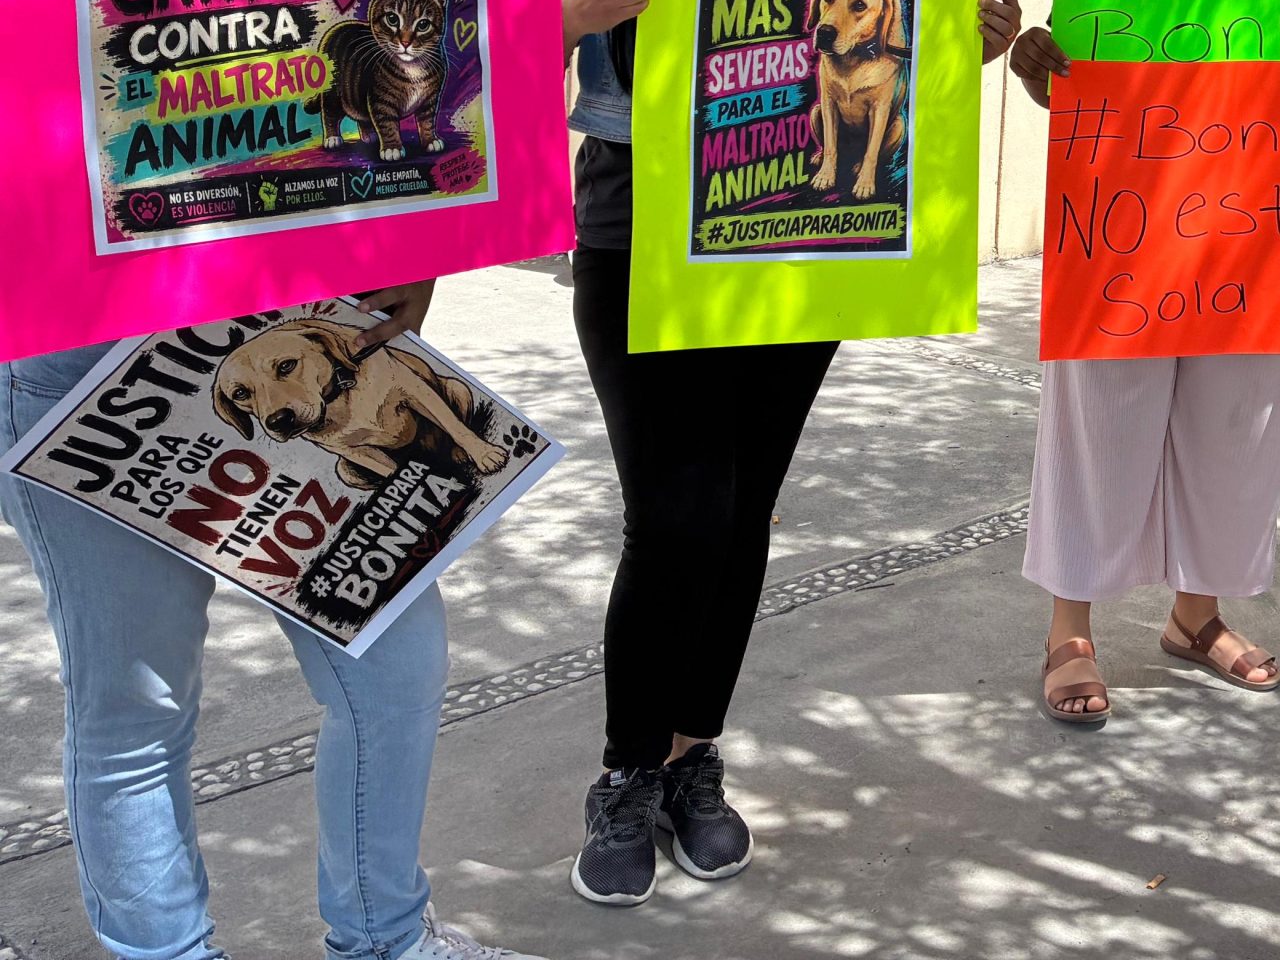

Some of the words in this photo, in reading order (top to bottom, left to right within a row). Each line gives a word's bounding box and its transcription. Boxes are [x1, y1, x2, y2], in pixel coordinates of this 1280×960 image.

[129, 7, 301, 65] CONTRA
[126, 80, 152, 101] EL
[158, 54, 326, 119] MALTRATO
[708, 42, 809, 94] SEVERAS
[717, 97, 764, 121] PARA
[770, 91, 791, 109] EL
[125, 102, 312, 178] ANIMAL
[702, 114, 810, 176] MALTRATO
[169, 193, 181, 204] NO
[184, 191, 194, 202] ES
[196, 184, 242, 200] DIVERSIÓN,
[284, 180, 315, 193] ALZAMOS
[316, 179, 325, 189] LA
[326, 177, 338, 187] VOZ
[286, 194, 300, 205] POR
[375, 170, 390, 183] MÁS
[375, 183, 398, 195] MENOS
[705, 152, 809, 213] ANIMAL
[171, 207, 183, 218] ES
[186, 200, 237, 216] VIOLENCIA
[1057, 176, 1148, 259] NO
[1097, 273, 1247, 337] Sola
[110, 435, 189, 504] PARA
[139, 477, 185, 519] LOS
[176, 432, 224, 474] QUE
[166, 449, 271, 546] NO
[215, 473, 301, 558] TIENEN
[238, 478, 351, 578] VOZ
[310, 460, 430, 598] #JUSTICIAPARA
[335, 474, 467, 609] BONITA
